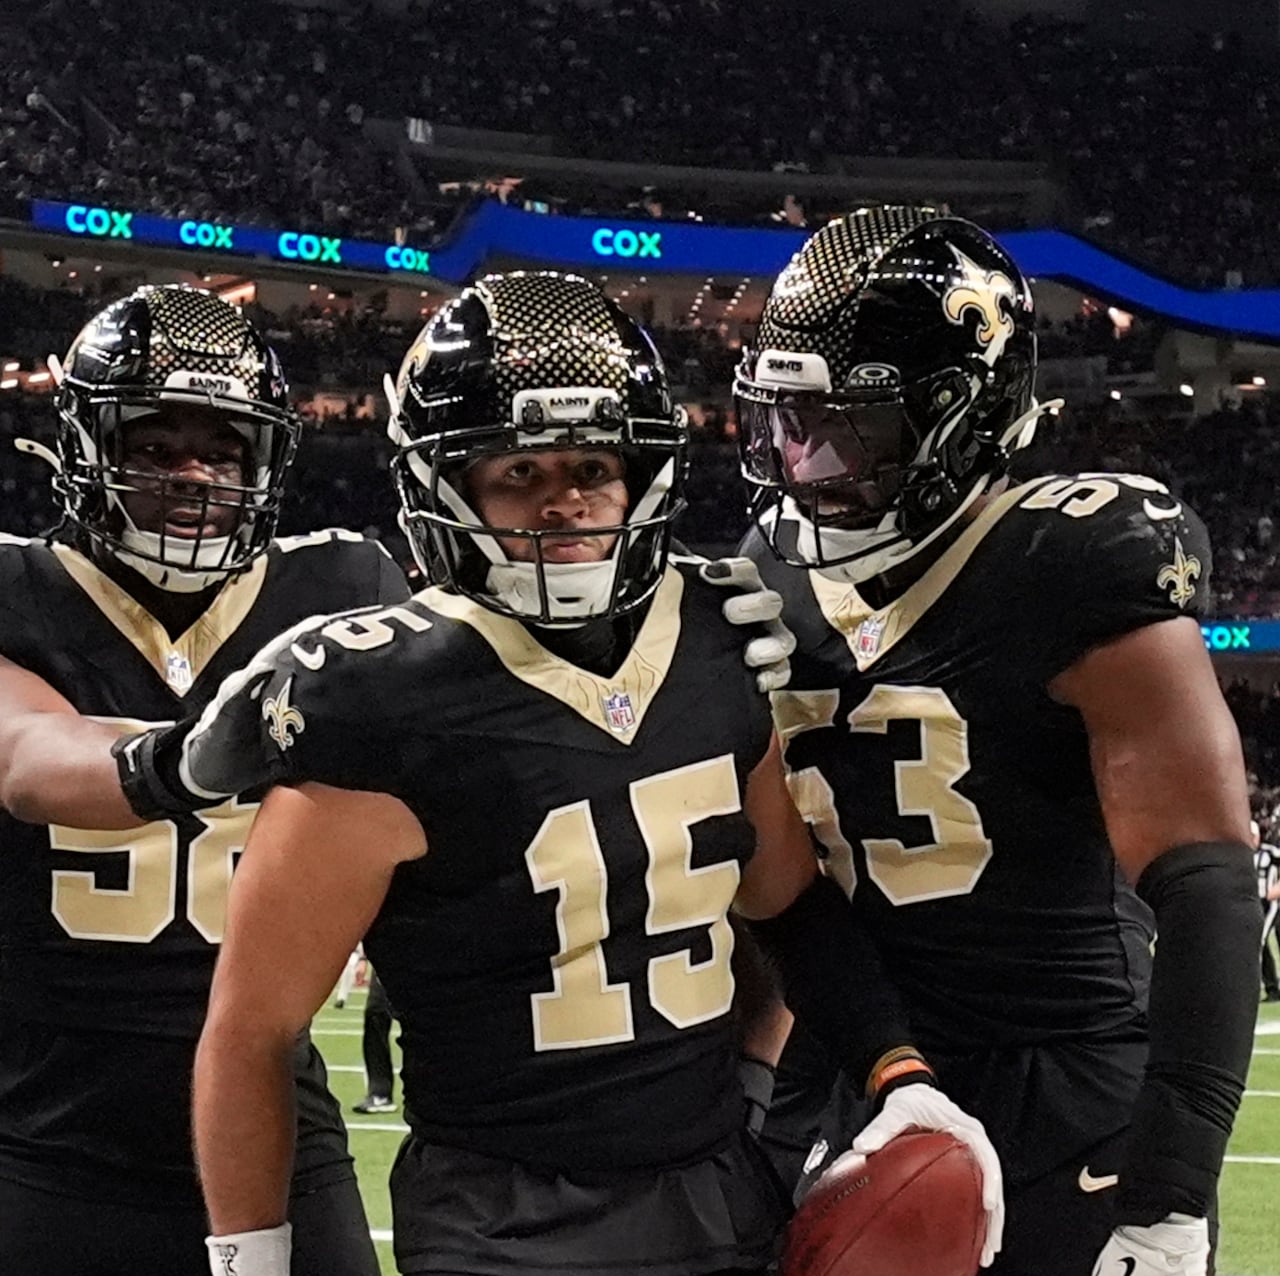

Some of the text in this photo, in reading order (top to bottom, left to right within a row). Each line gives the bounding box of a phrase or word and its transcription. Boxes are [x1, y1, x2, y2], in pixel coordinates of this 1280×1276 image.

[65, 206, 133, 239] COX
[179, 220, 233, 250] COX
[278, 231, 342, 263] COX
[384, 244, 430, 272] COX
[592, 228, 662, 259] COX
[609, 708, 633, 726] NFL
[524, 753, 742, 1052] 15
